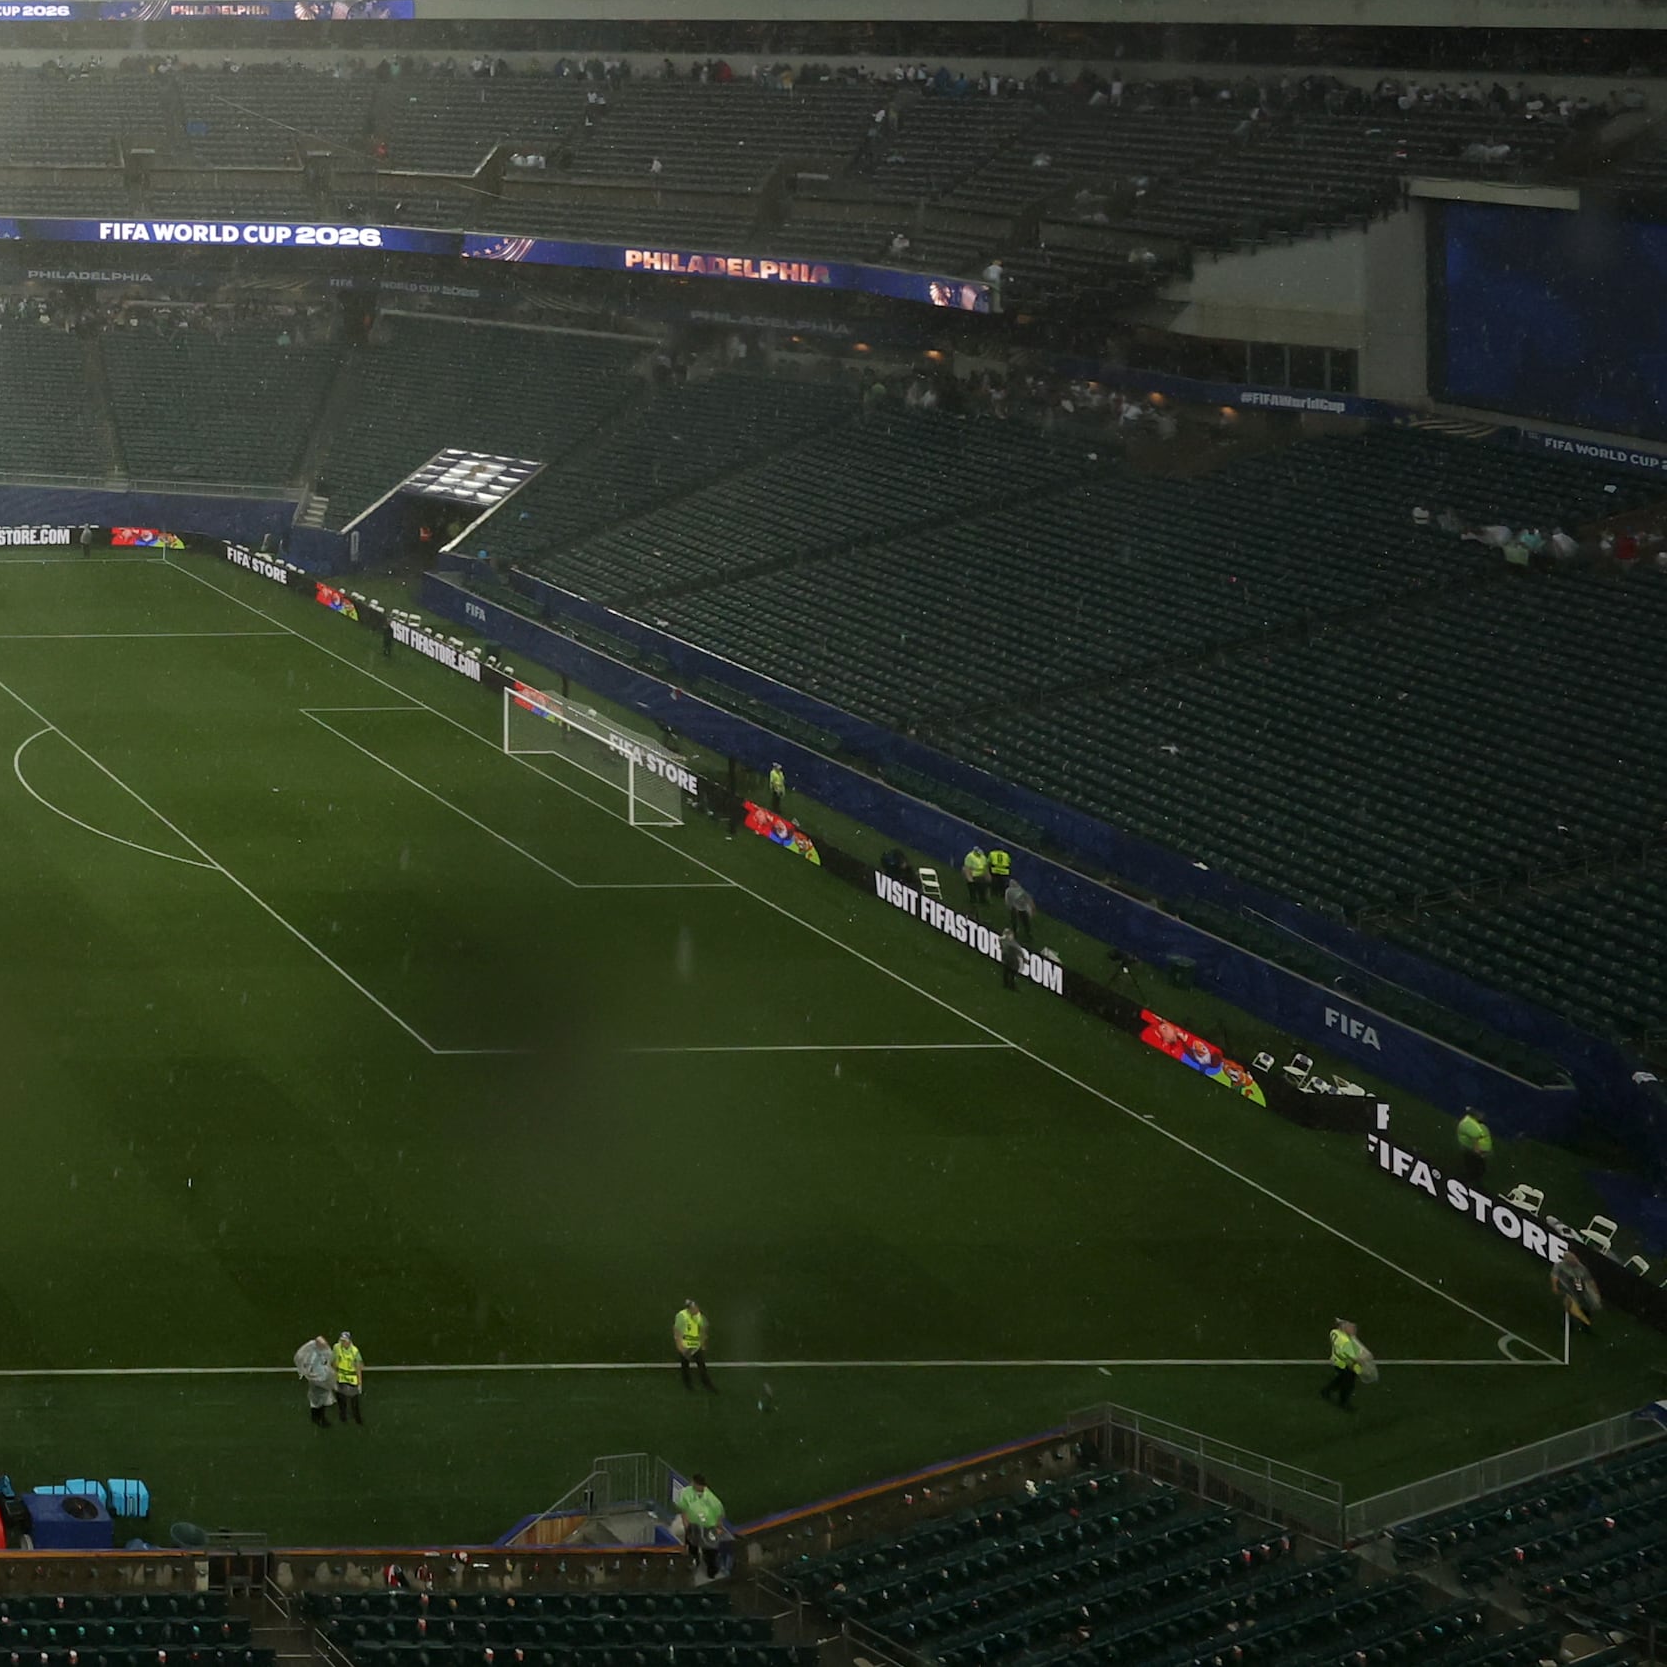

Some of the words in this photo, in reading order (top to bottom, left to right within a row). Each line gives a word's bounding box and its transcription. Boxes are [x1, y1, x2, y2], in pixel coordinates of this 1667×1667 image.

[22, 5, 70, 16] 2026
[99, 222, 150, 241] FIFA
[152, 223, 241, 244] WORLD
[243, 225, 292, 245] CUP
[294, 227, 383, 247] 2026
[624, 249, 831, 284] PHILADELPHIA
[1544, 437, 1574, 454] FIFA
[1574, 443, 1628, 464] WORLD
[1629, 452, 1659, 469] CUP
[252, 555, 287, 584] STORE
[465, 602, 486, 622] FIFA
[410, 629, 481, 682] FIFASTORE.COM
[647, 753, 698, 795] STORE
[874, 870, 918, 916] VISIT
[920, 895, 1063, 995] FIFASTORCOM
[1324, 1005, 1381, 1051] FIFA
[1446, 1179, 1568, 1265] STORE
